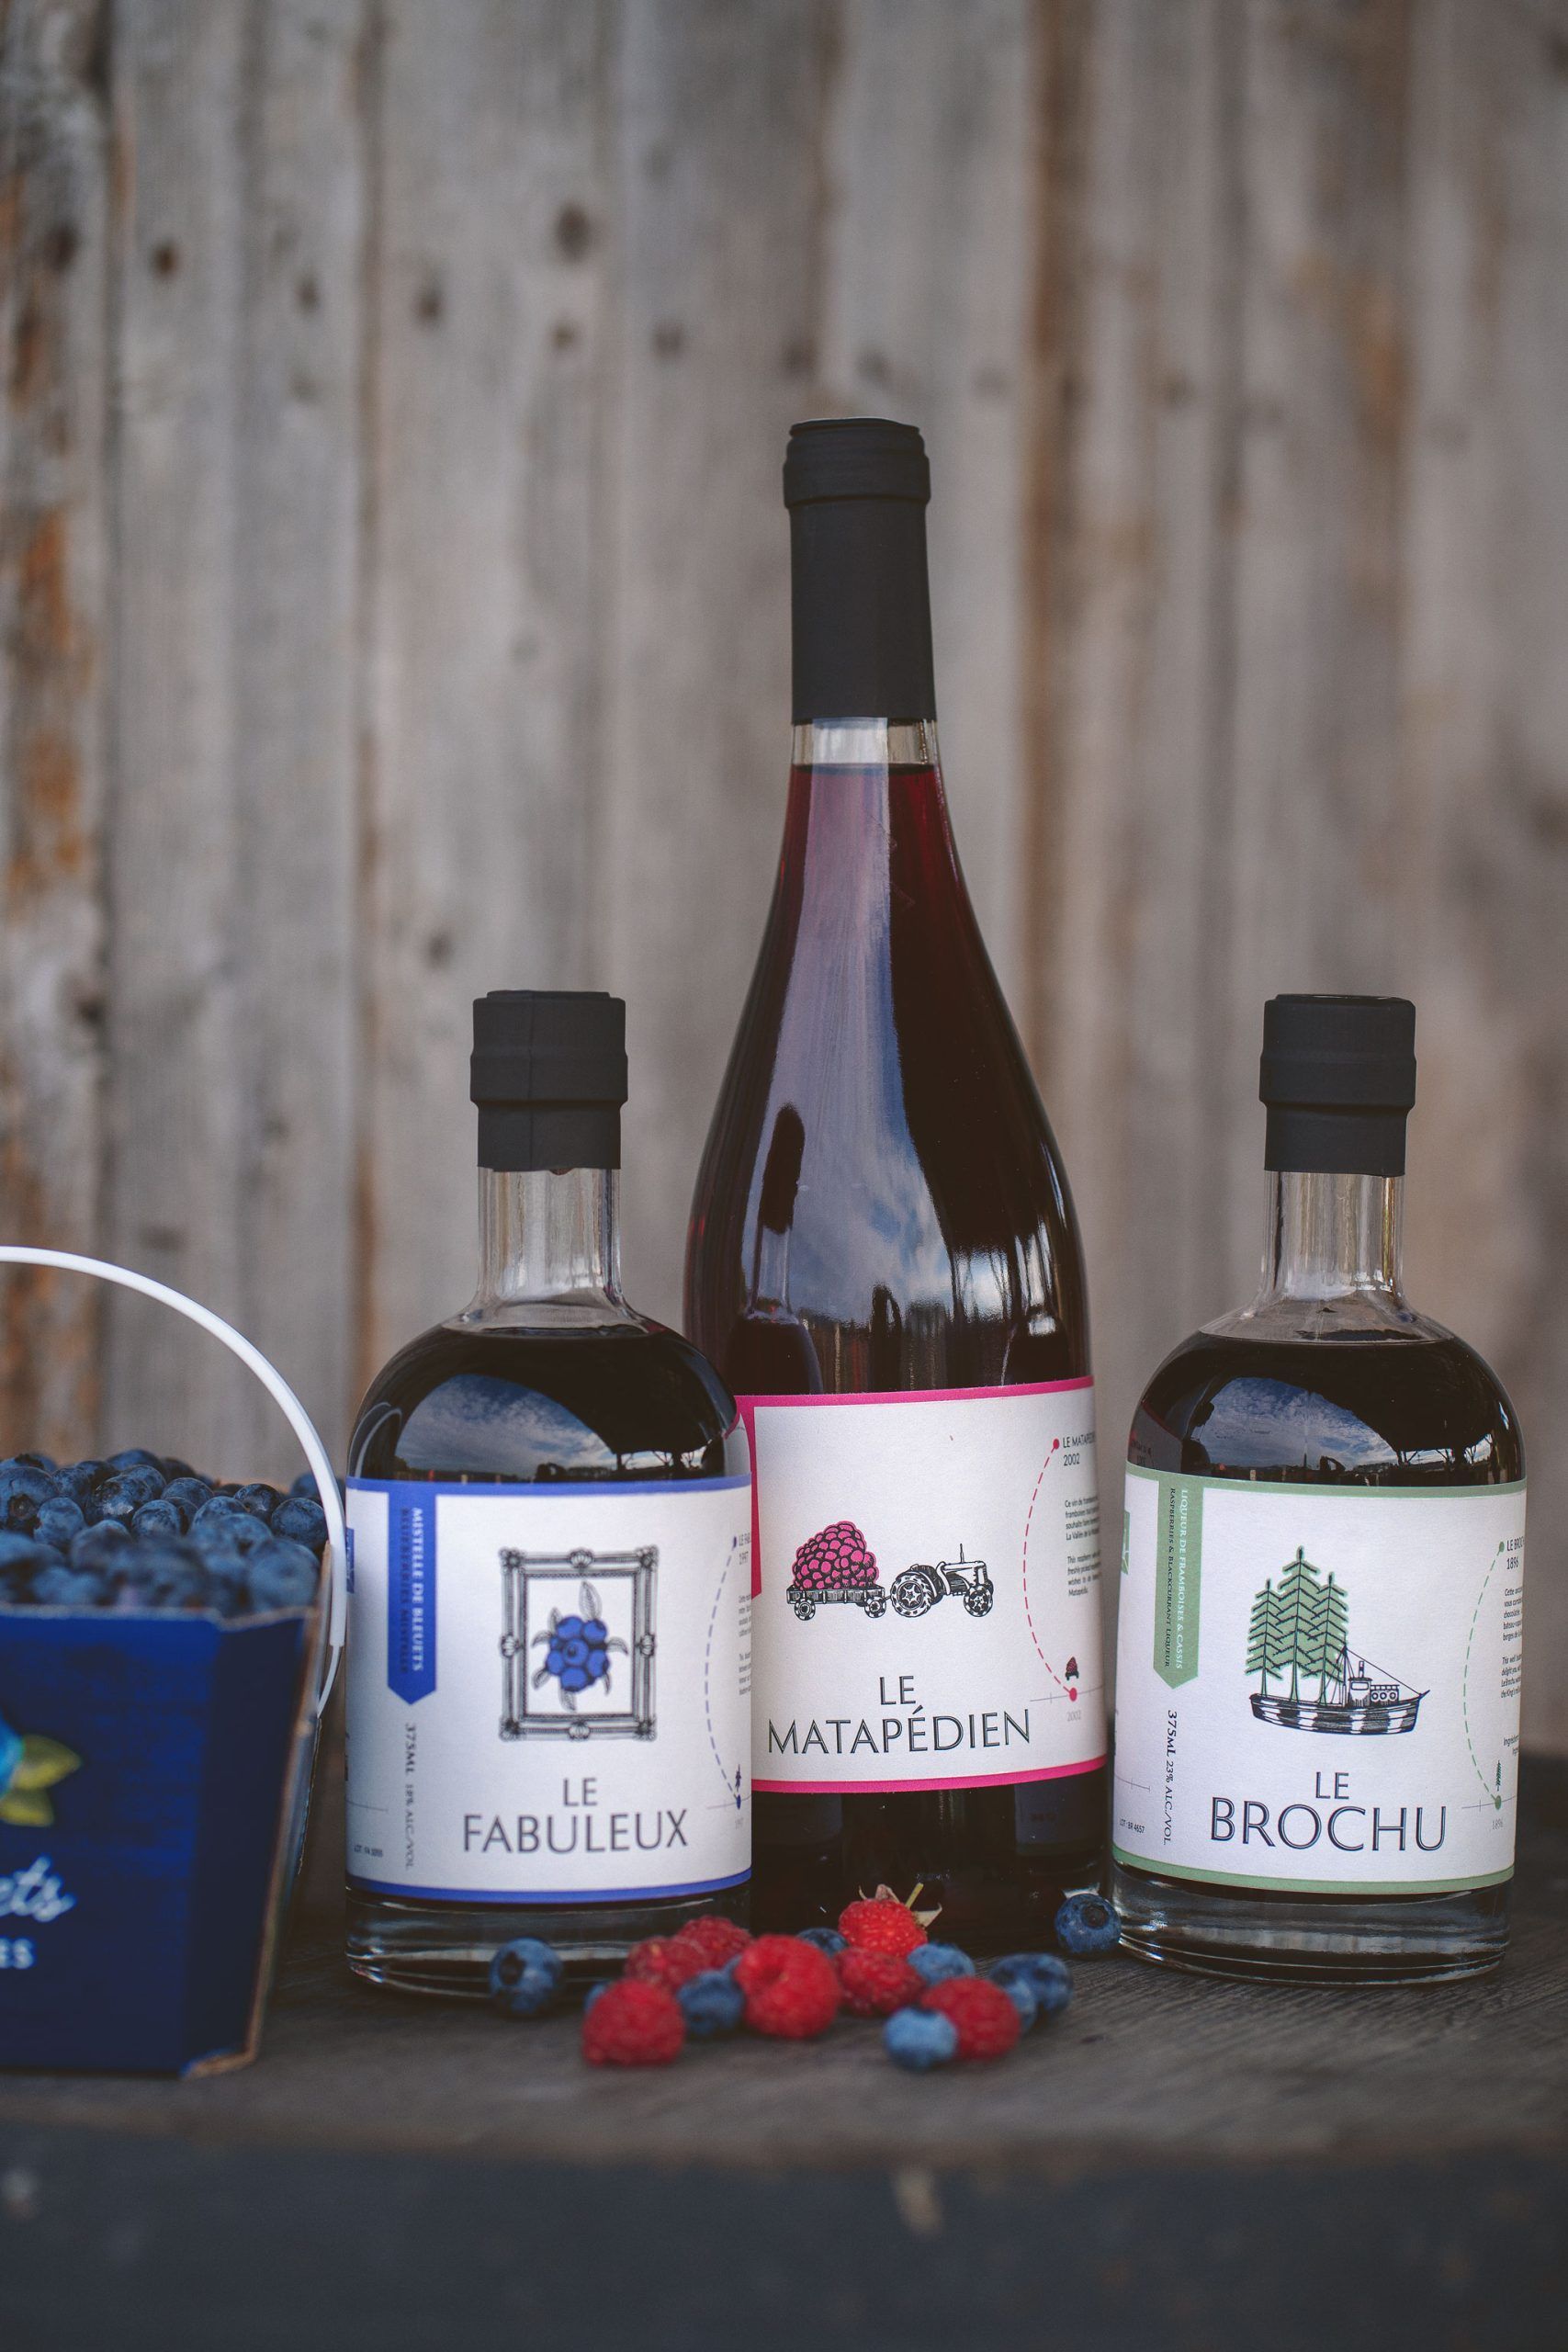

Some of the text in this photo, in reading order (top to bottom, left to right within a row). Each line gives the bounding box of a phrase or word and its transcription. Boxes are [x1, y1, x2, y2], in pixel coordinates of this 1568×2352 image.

[1063, 1436, 1071, 1448] LE
[1064, 1453, 1080, 1466] 2002
[1066, 1532, 1072, 1541] La
[1168, 1545, 1175, 1554] &
[1507, 1540, 1513, 1551] LE
[1506, 1556, 1518, 1569] 1896
[411, 1508, 424, 1672] MISTELLE DE BLEUETS
[1176, 1489, 1188, 1668] LIQUEUR DE FRAMBOISES & CASSIS
[1164, 1628, 1172, 1668] LIQUEUR
[879, 1675, 917, 1706] LE
[768, 1705, 1032, 1755] MATAPÉDIEN
[562, 1778, 598, 1807] LE
[1314, 1771, 1350, 1801] LE
[463, 1808, 689, 1855] FABULEUX
[1210, 1796, 1448, 1852] BROCHU
